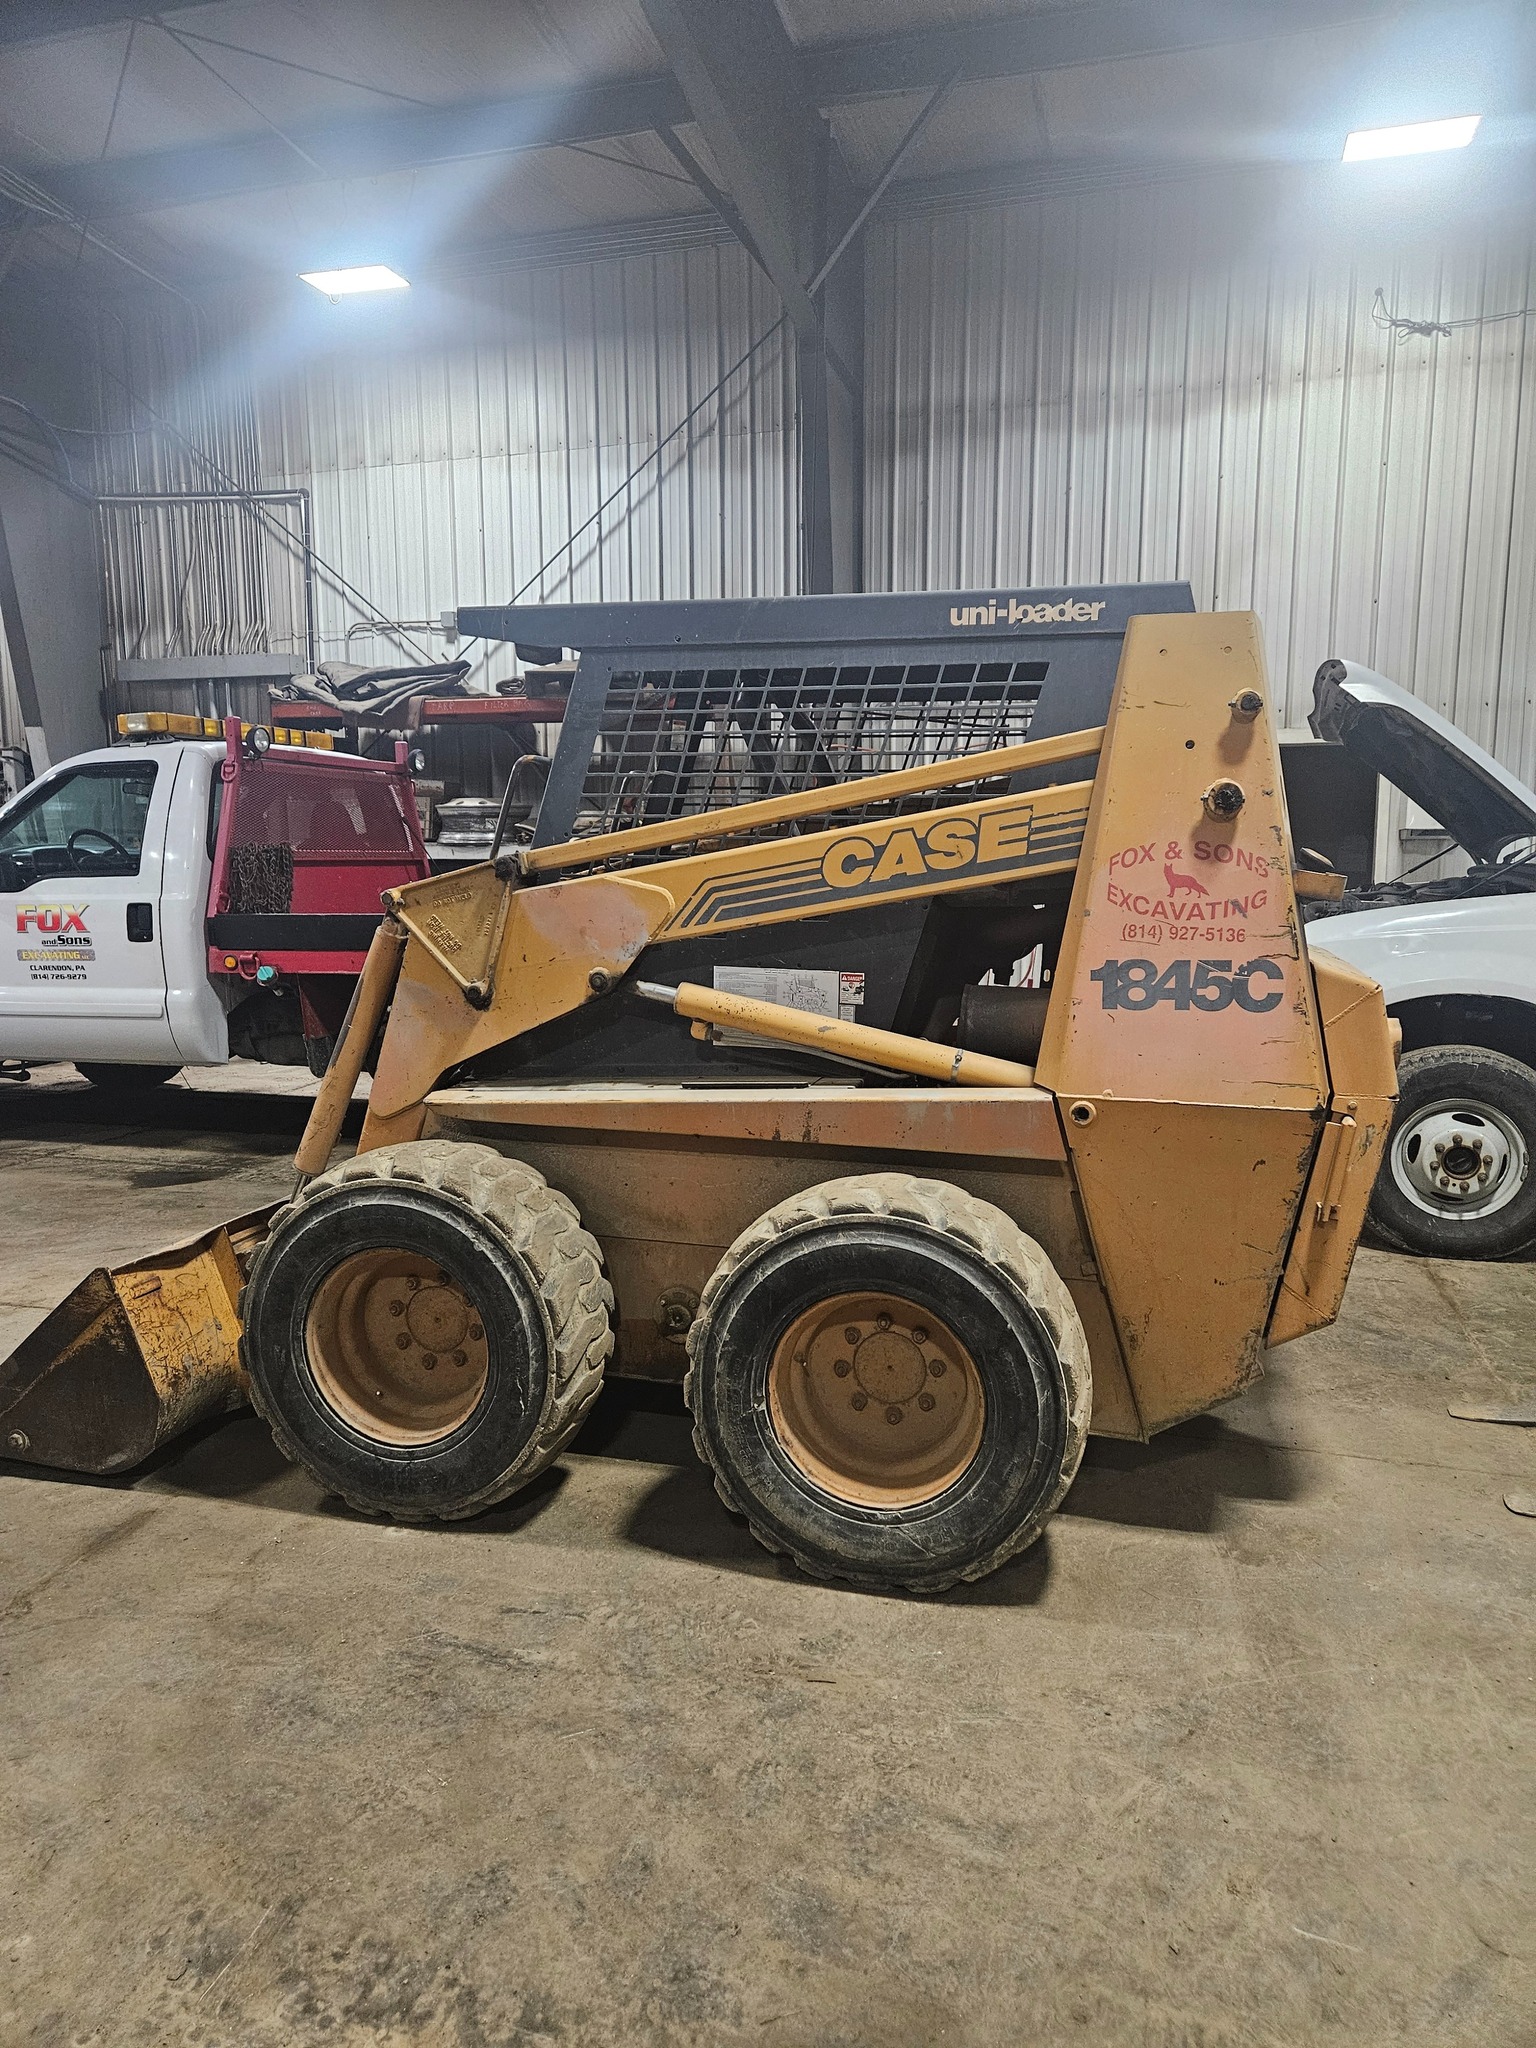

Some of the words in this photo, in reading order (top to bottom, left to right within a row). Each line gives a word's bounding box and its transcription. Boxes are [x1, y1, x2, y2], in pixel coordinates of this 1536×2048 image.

[950, 597, 1105, 626] uni-loader
[822, 805, 1033, 888] CASE
[1109, 842, 1156, 876] FOX
[1164, 841, 1183, 860] &
[1193, 840, 1269, 878] SONS
[1107, 883, 1268, 921] EXCAVATING
[16, 904, 90, 933] FOX
[1122, 923, 1163, 943] (814)
[1169, 926, 1246, 943] 927-5136
[57, 934, 92, 946] Sons
[22, 951, 80, 960] EXCAVATING
[1090, 958, 1284, 1013] 1845C
